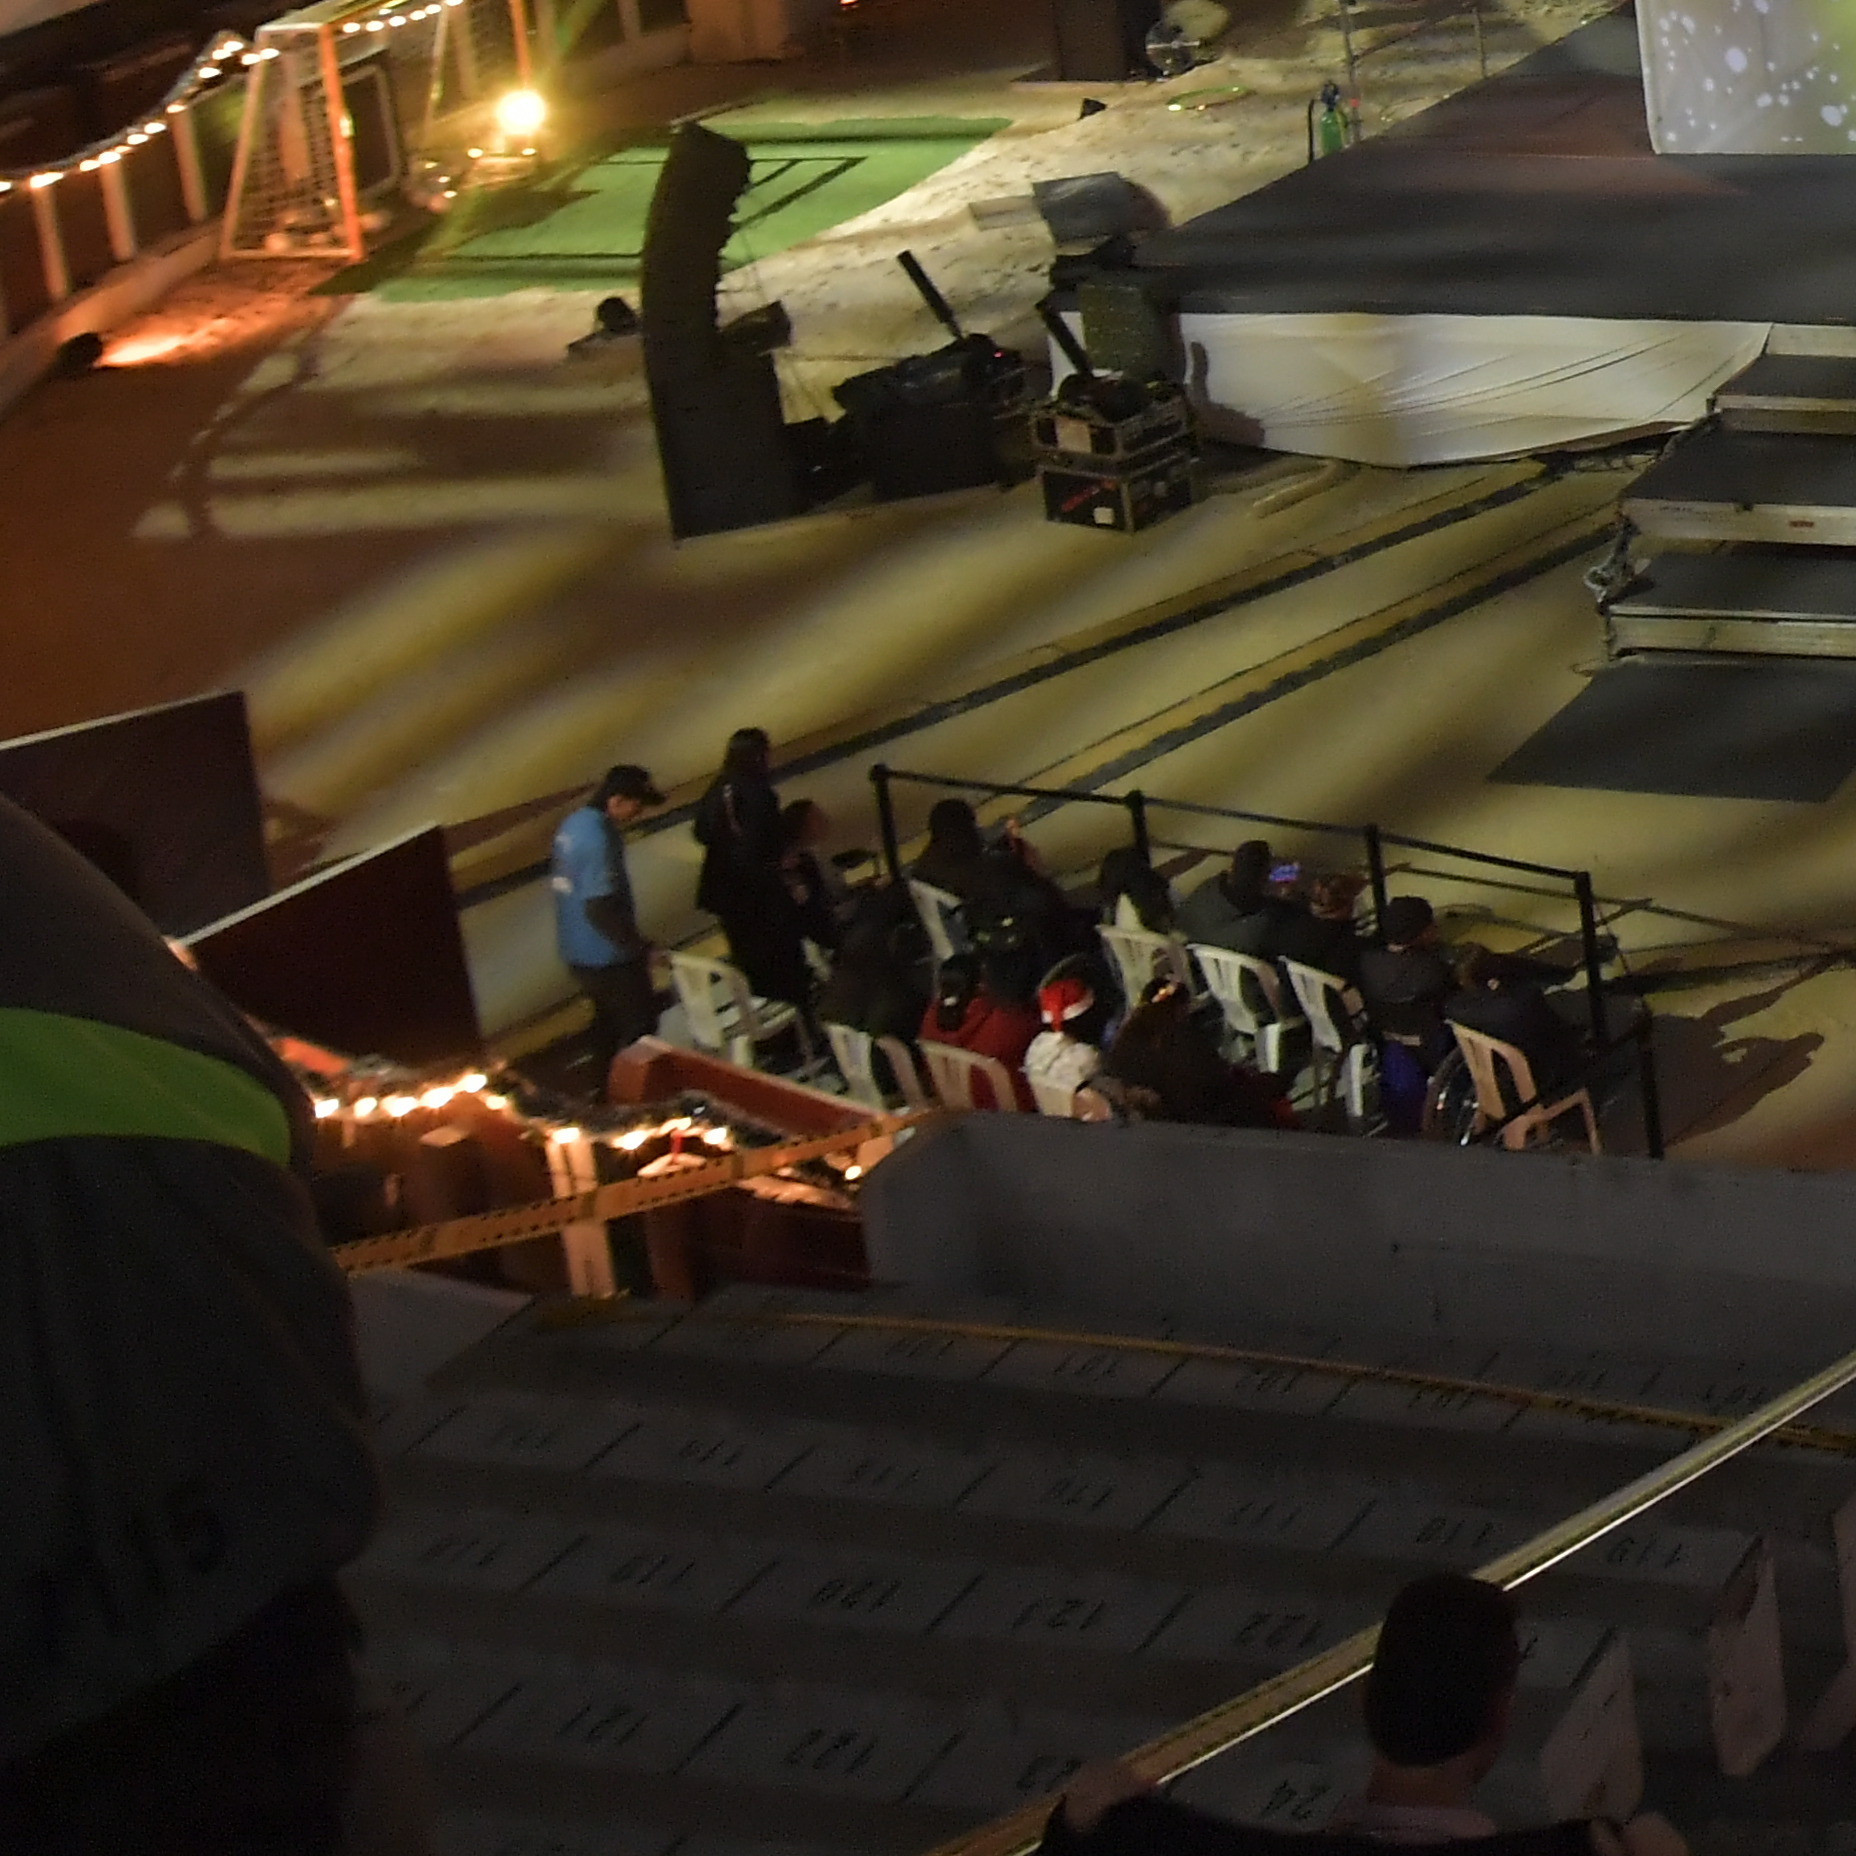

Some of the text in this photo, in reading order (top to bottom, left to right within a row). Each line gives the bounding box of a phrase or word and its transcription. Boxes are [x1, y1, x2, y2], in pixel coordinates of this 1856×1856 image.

[1608, 1539, 1681, 1567] 119
[807, 1576, 900, 1614] 120
[1010, 1599, 1107, 1632] 121
[1234, 1612, 1320, 1649] 122
[555, 1703, 649, 1746] 121
[781, 1729, 878, 1774] 122
